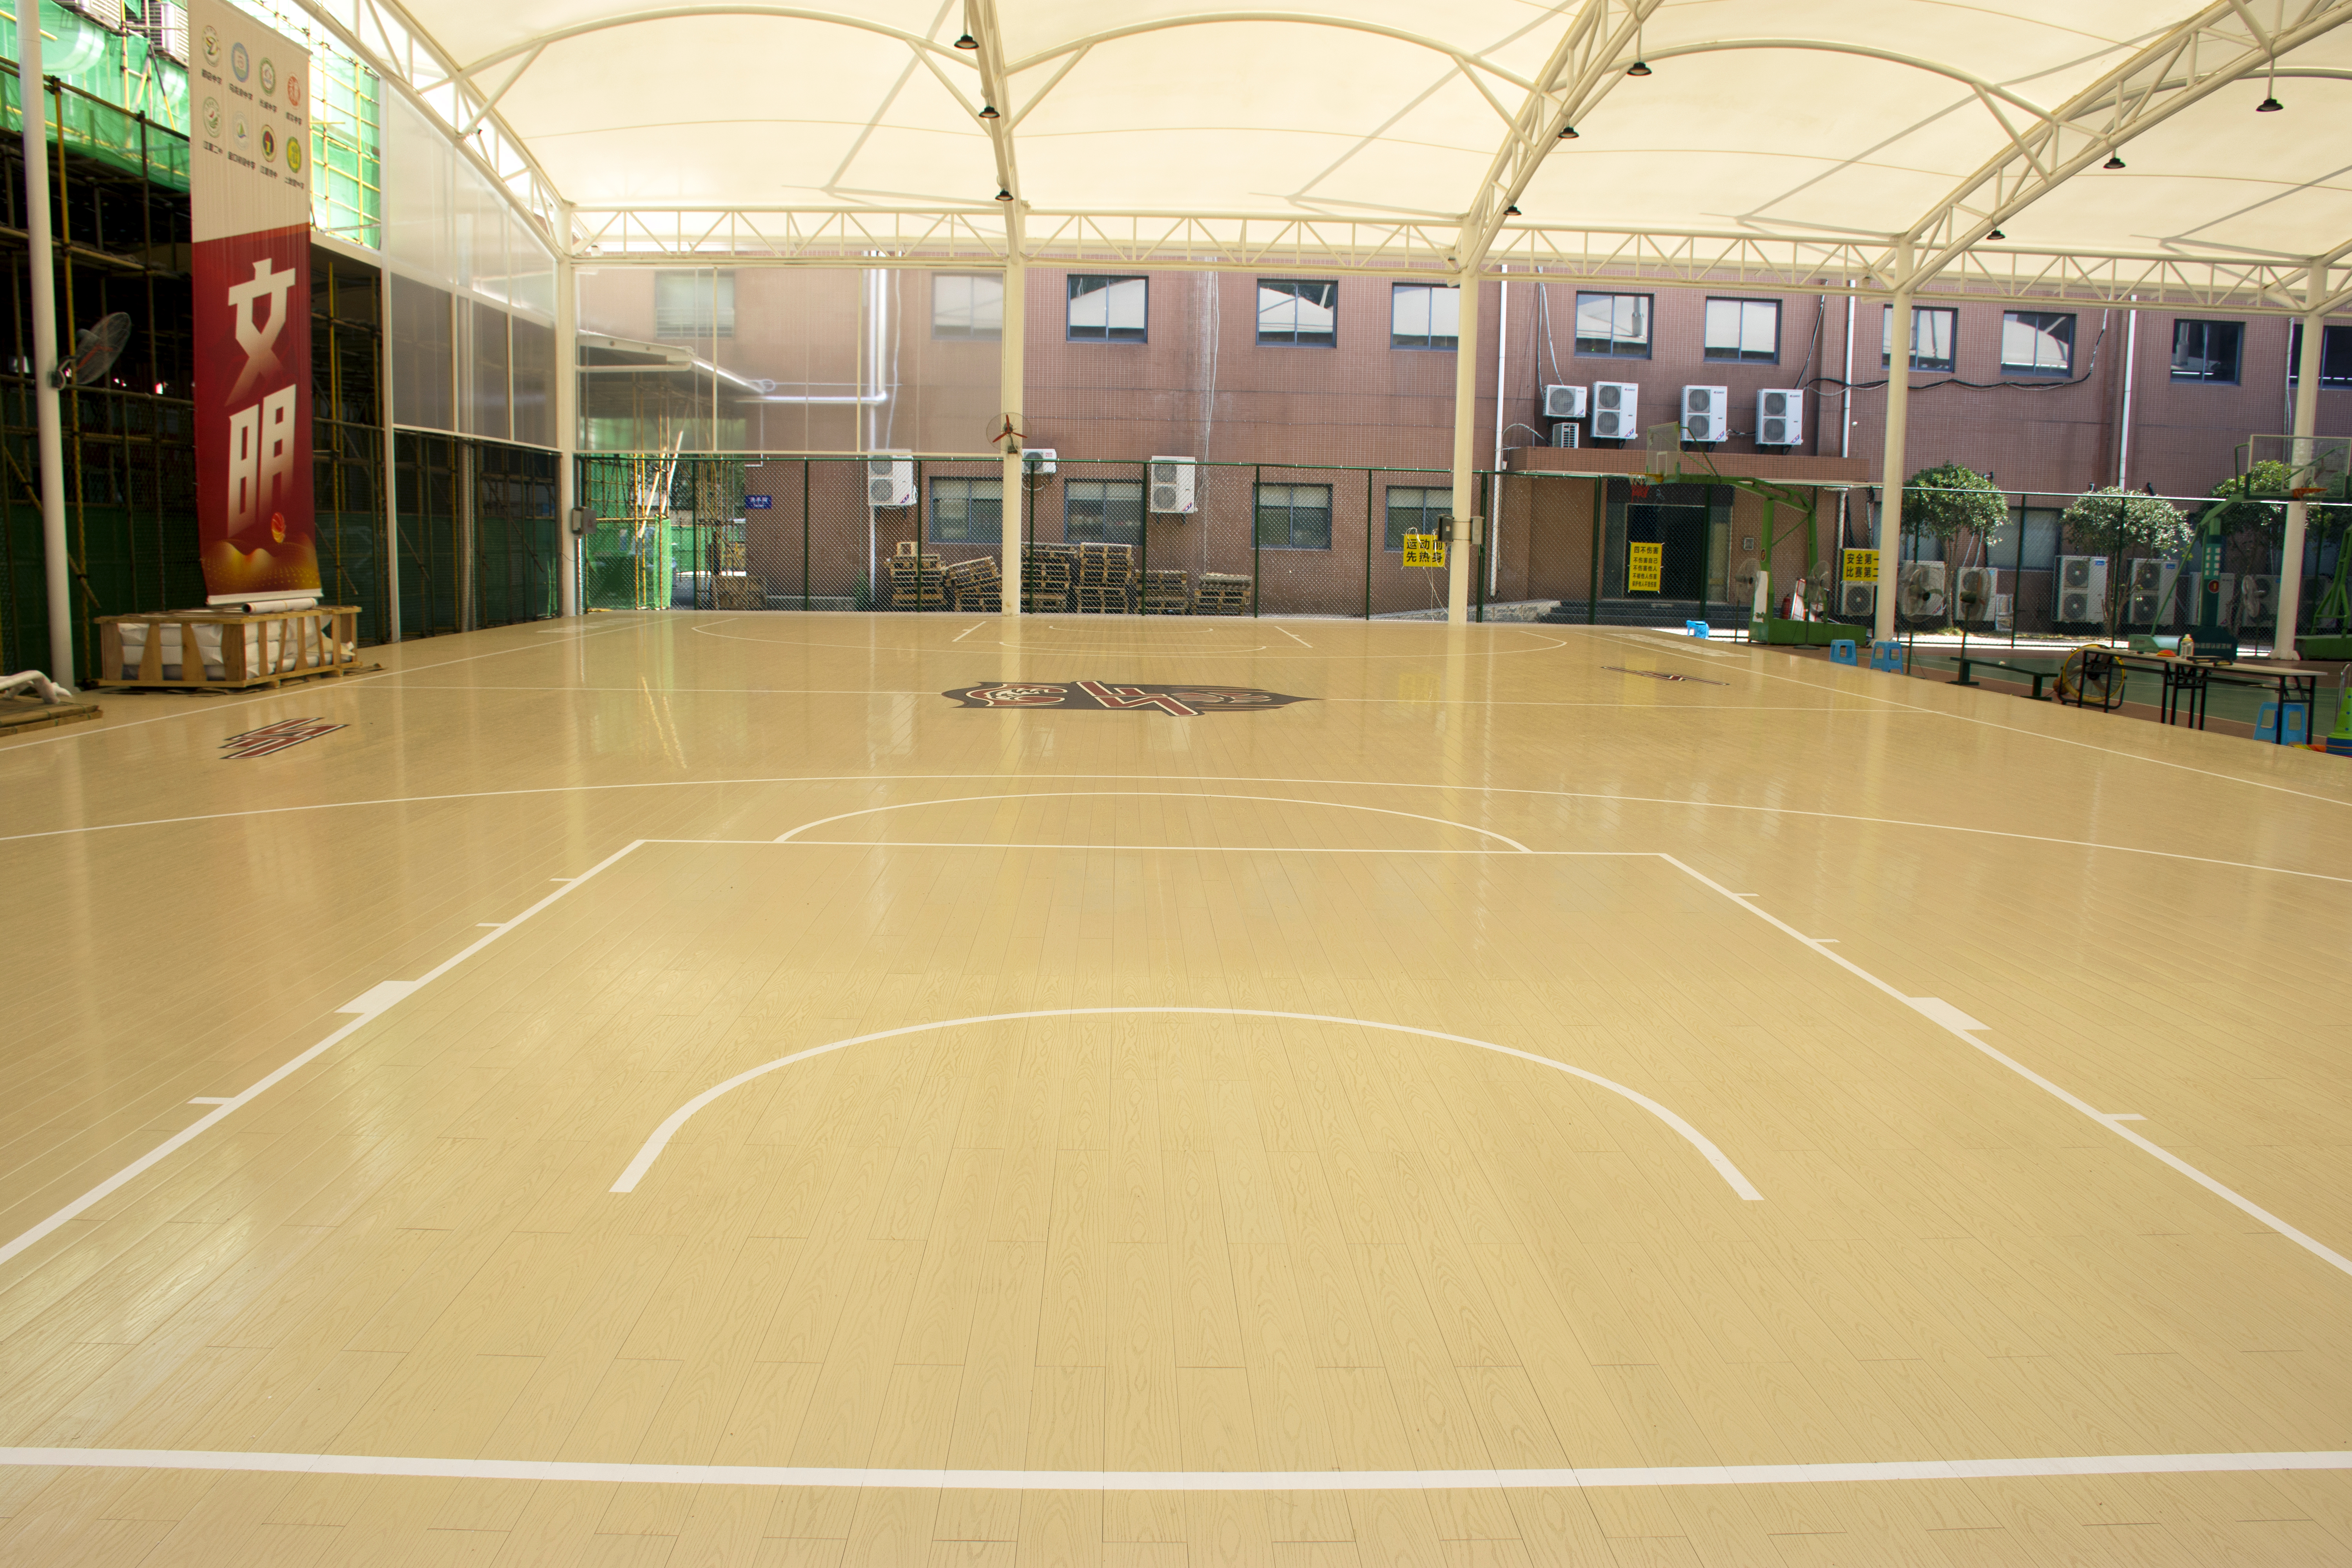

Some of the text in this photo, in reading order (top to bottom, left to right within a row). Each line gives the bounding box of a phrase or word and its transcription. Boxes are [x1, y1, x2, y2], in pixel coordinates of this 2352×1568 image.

[225, 258, 296, 538] 文明
[1406, 551, 1443, 563] 先热身
[1847, 553, 1879, 564] 安全第一
[1846, 566, 1878, 577] 比赛第二
